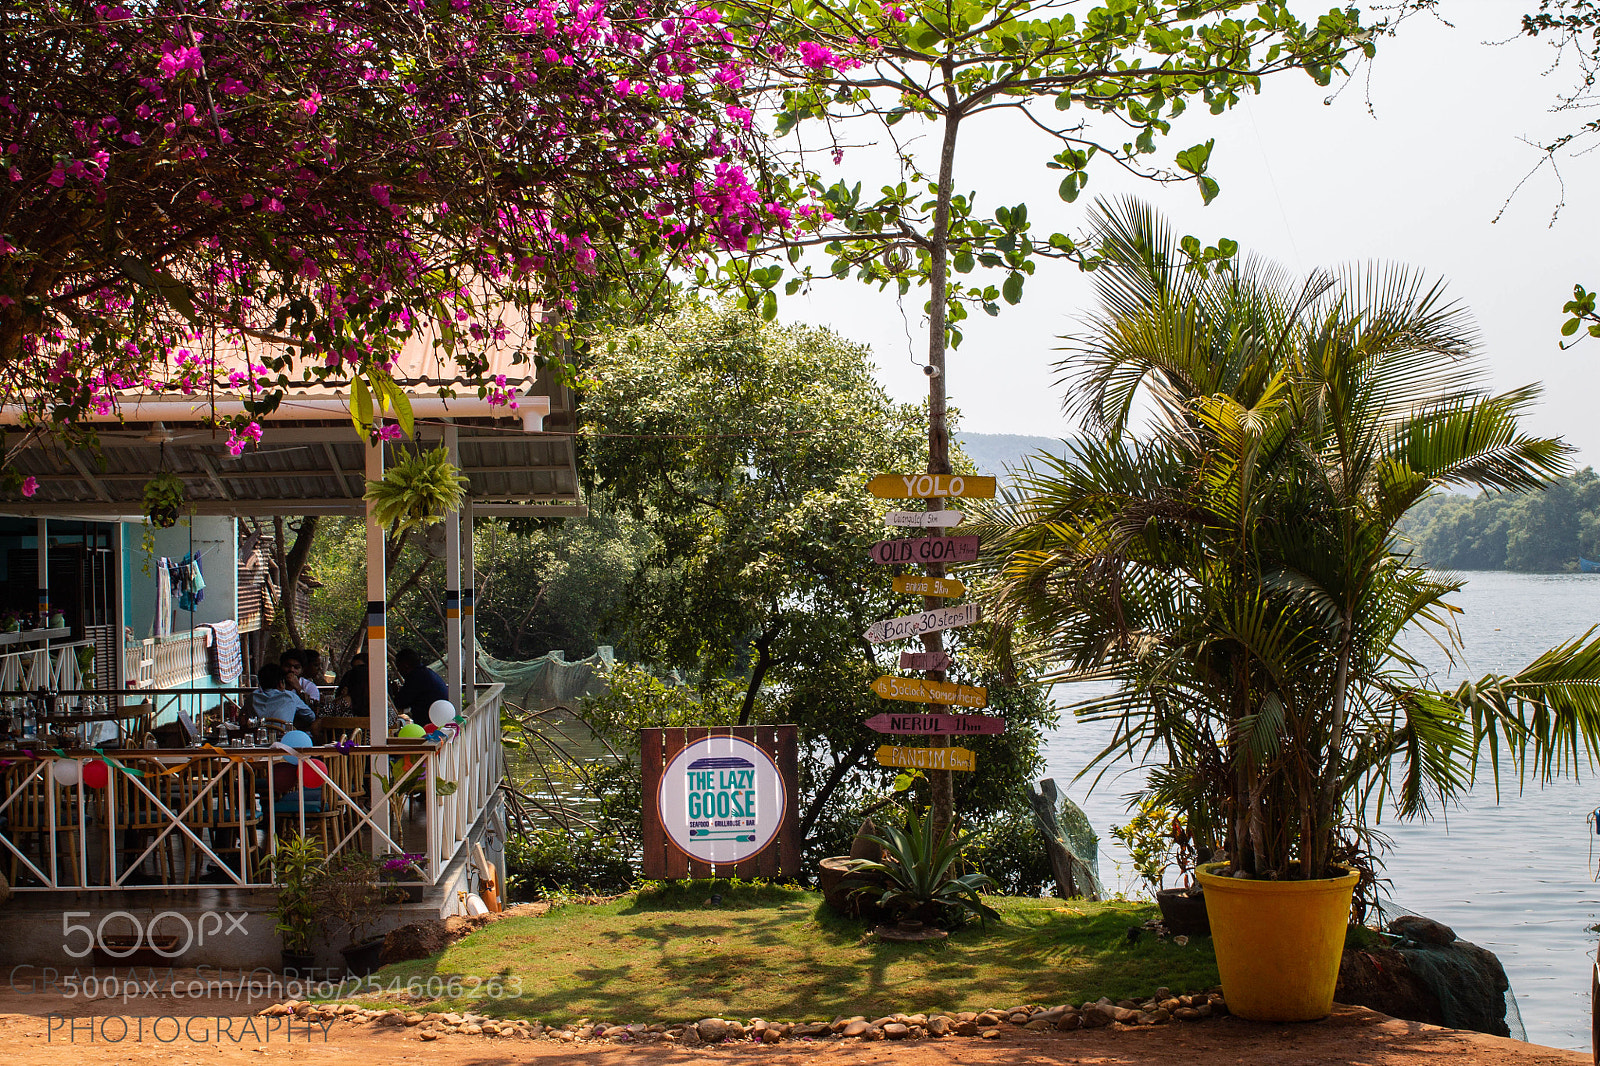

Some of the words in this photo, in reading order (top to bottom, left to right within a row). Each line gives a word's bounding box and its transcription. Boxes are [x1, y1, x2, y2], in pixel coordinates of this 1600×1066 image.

[902, 475, 965, 497] YOLO
[880, 542, 912, 562] OLD
[919, 540, 956, 560] GOA
[884, 621, 911, 640] Bar
[890, 716, 945, 732] NERUL
[892, 747, 945, 769] PANJIM
[687, 771, 715, 791] THE
[720, 770, 755, 790] LAZY
[688, 790, 756, 820] GOOSE
[714, 819, 741, 827] GRILLHOUSE
